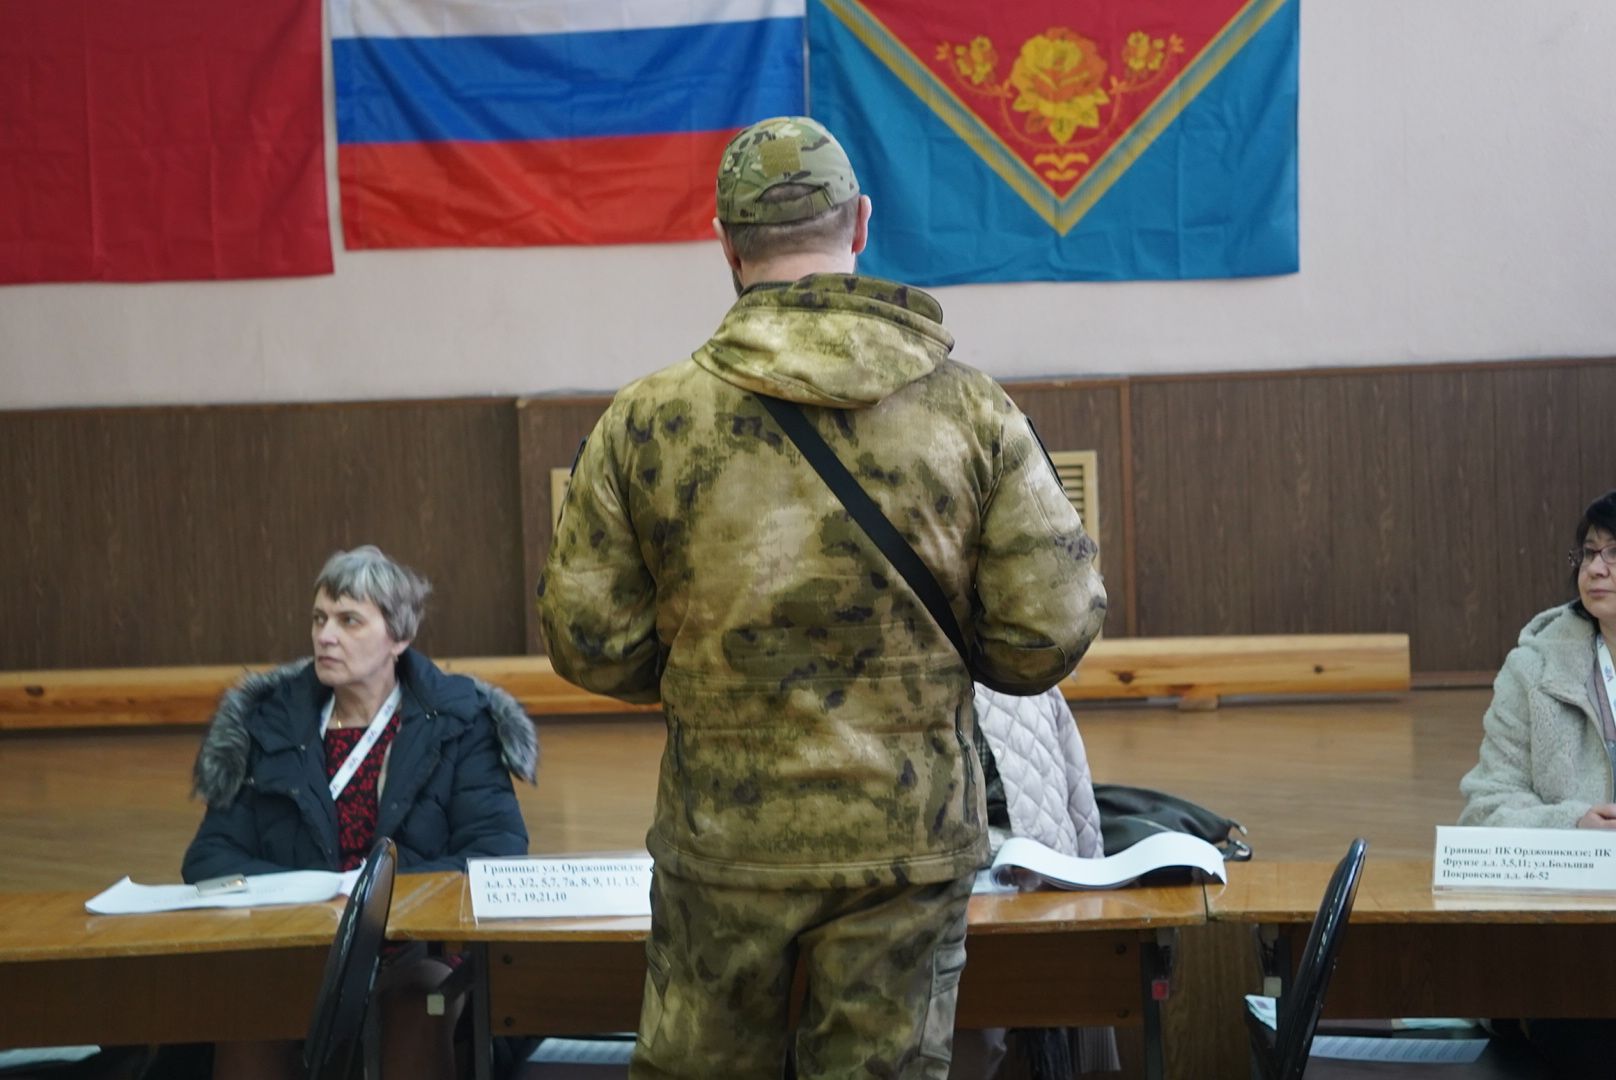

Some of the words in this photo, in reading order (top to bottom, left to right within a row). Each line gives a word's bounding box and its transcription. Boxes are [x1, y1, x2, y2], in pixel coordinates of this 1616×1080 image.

[1495, 846, 1511, 855] ПК
[1594, 848, 1612, 857] ПК
[1524, 871, 1550, 880] 46-52
